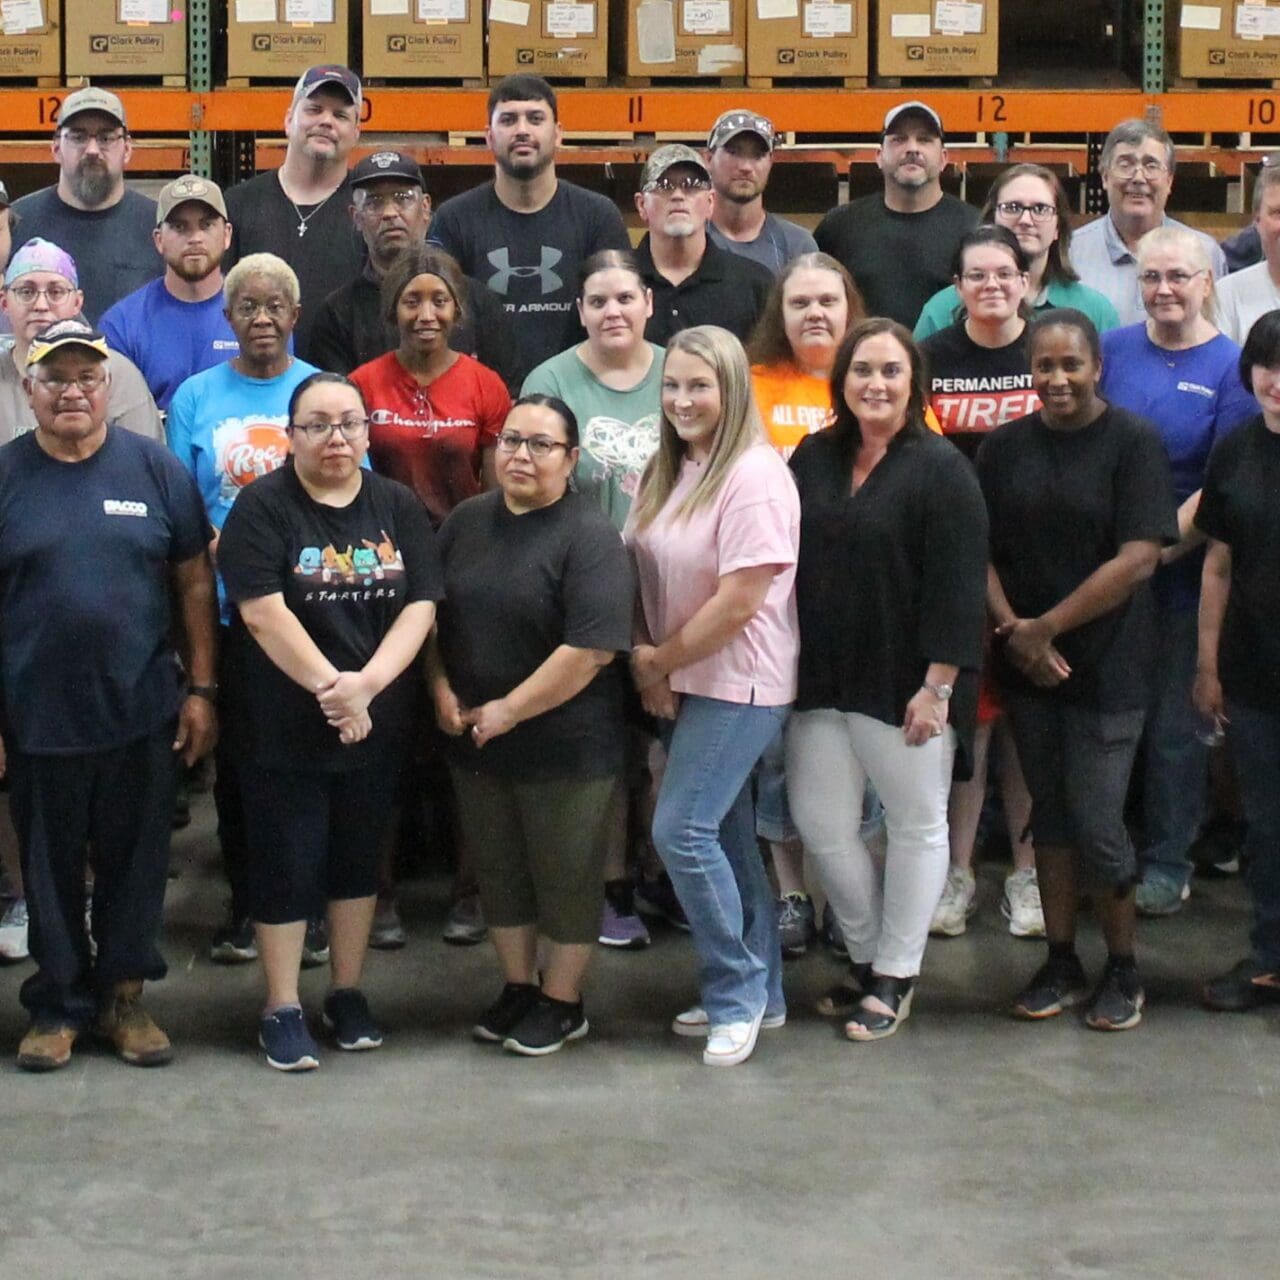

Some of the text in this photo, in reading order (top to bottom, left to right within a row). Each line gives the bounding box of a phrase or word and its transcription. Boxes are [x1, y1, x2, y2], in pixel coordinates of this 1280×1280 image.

[977, 95, 1007, 122] 12
[1248, 98, 1276, 125] 10
[371, 409, 476, 431] Champion
[772, 405, 794, 425] ALL
